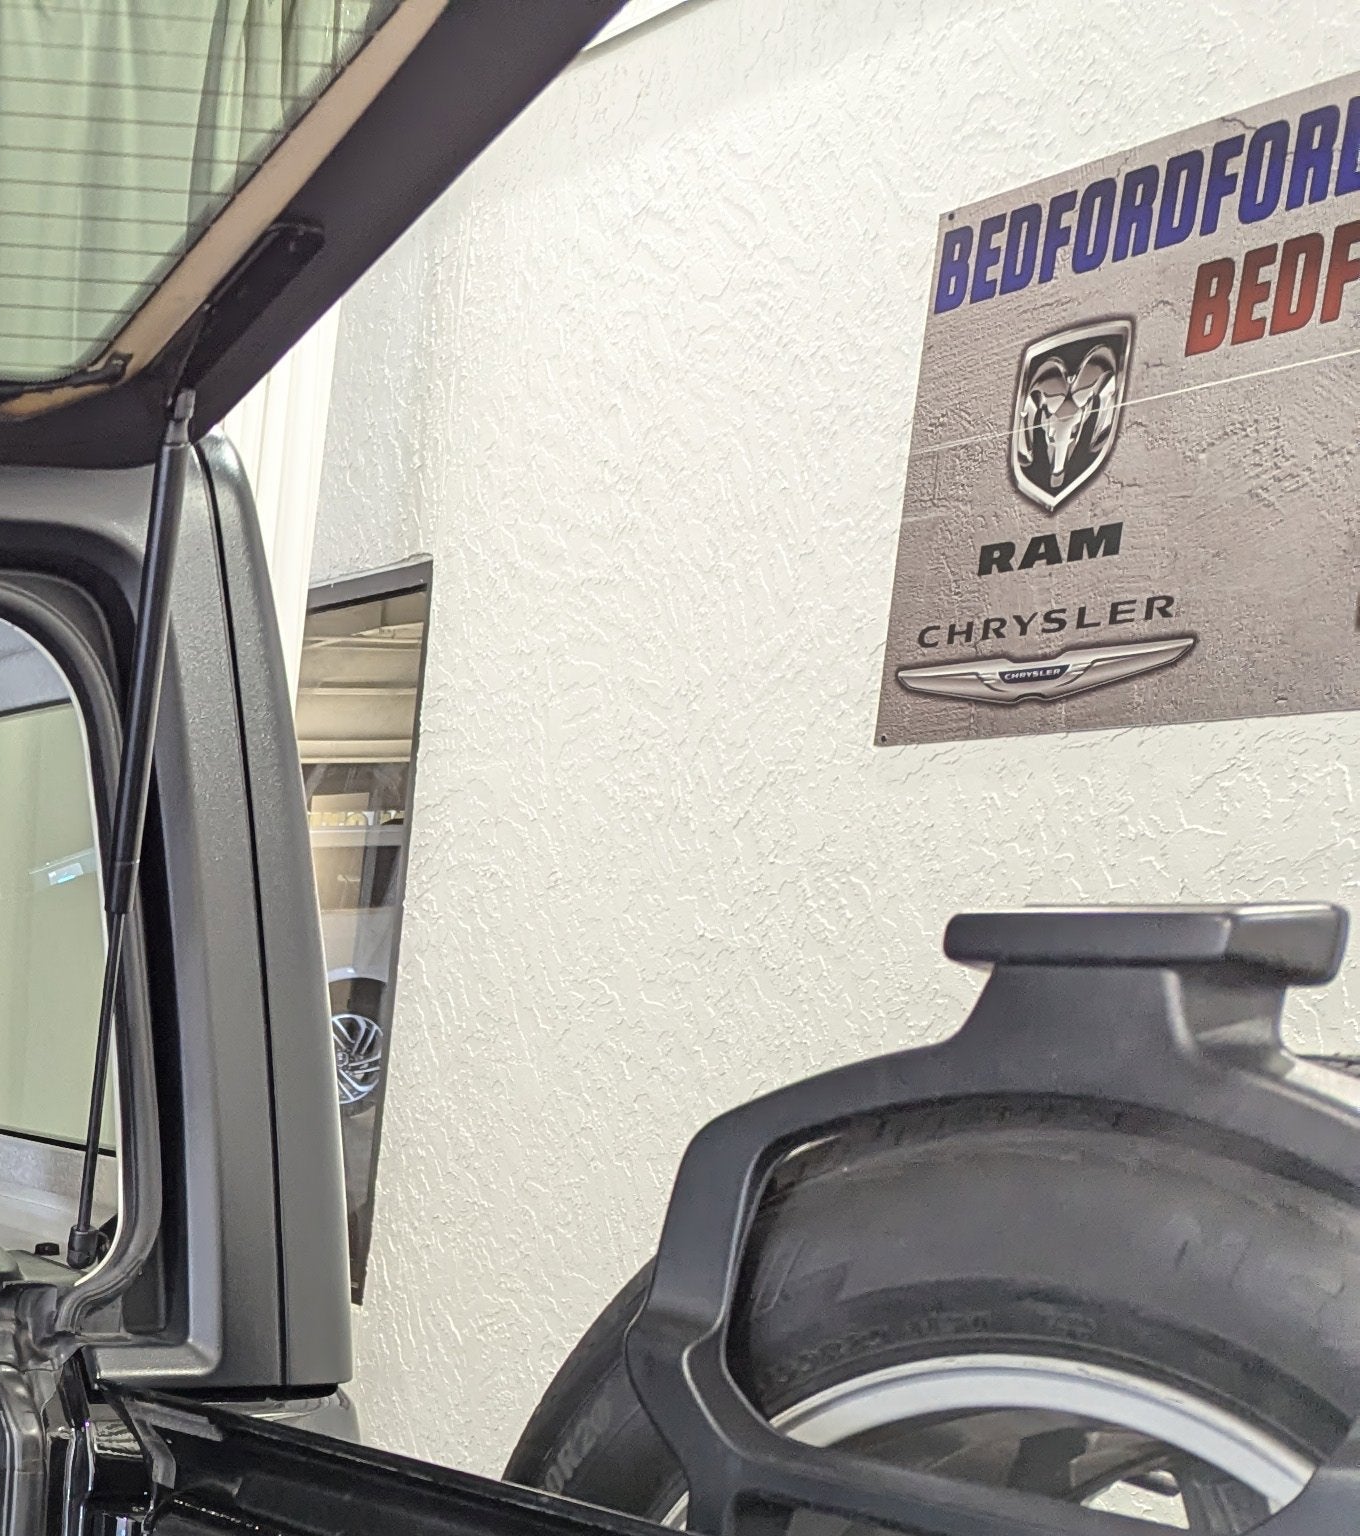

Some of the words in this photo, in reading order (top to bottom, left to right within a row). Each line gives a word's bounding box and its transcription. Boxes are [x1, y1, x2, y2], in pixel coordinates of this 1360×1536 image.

[978, 521, 1124, 576] RAM
[917, 595, 1175, 648] CHRYSLER
[1004, 668, 1061, 681] CHRYSLER
